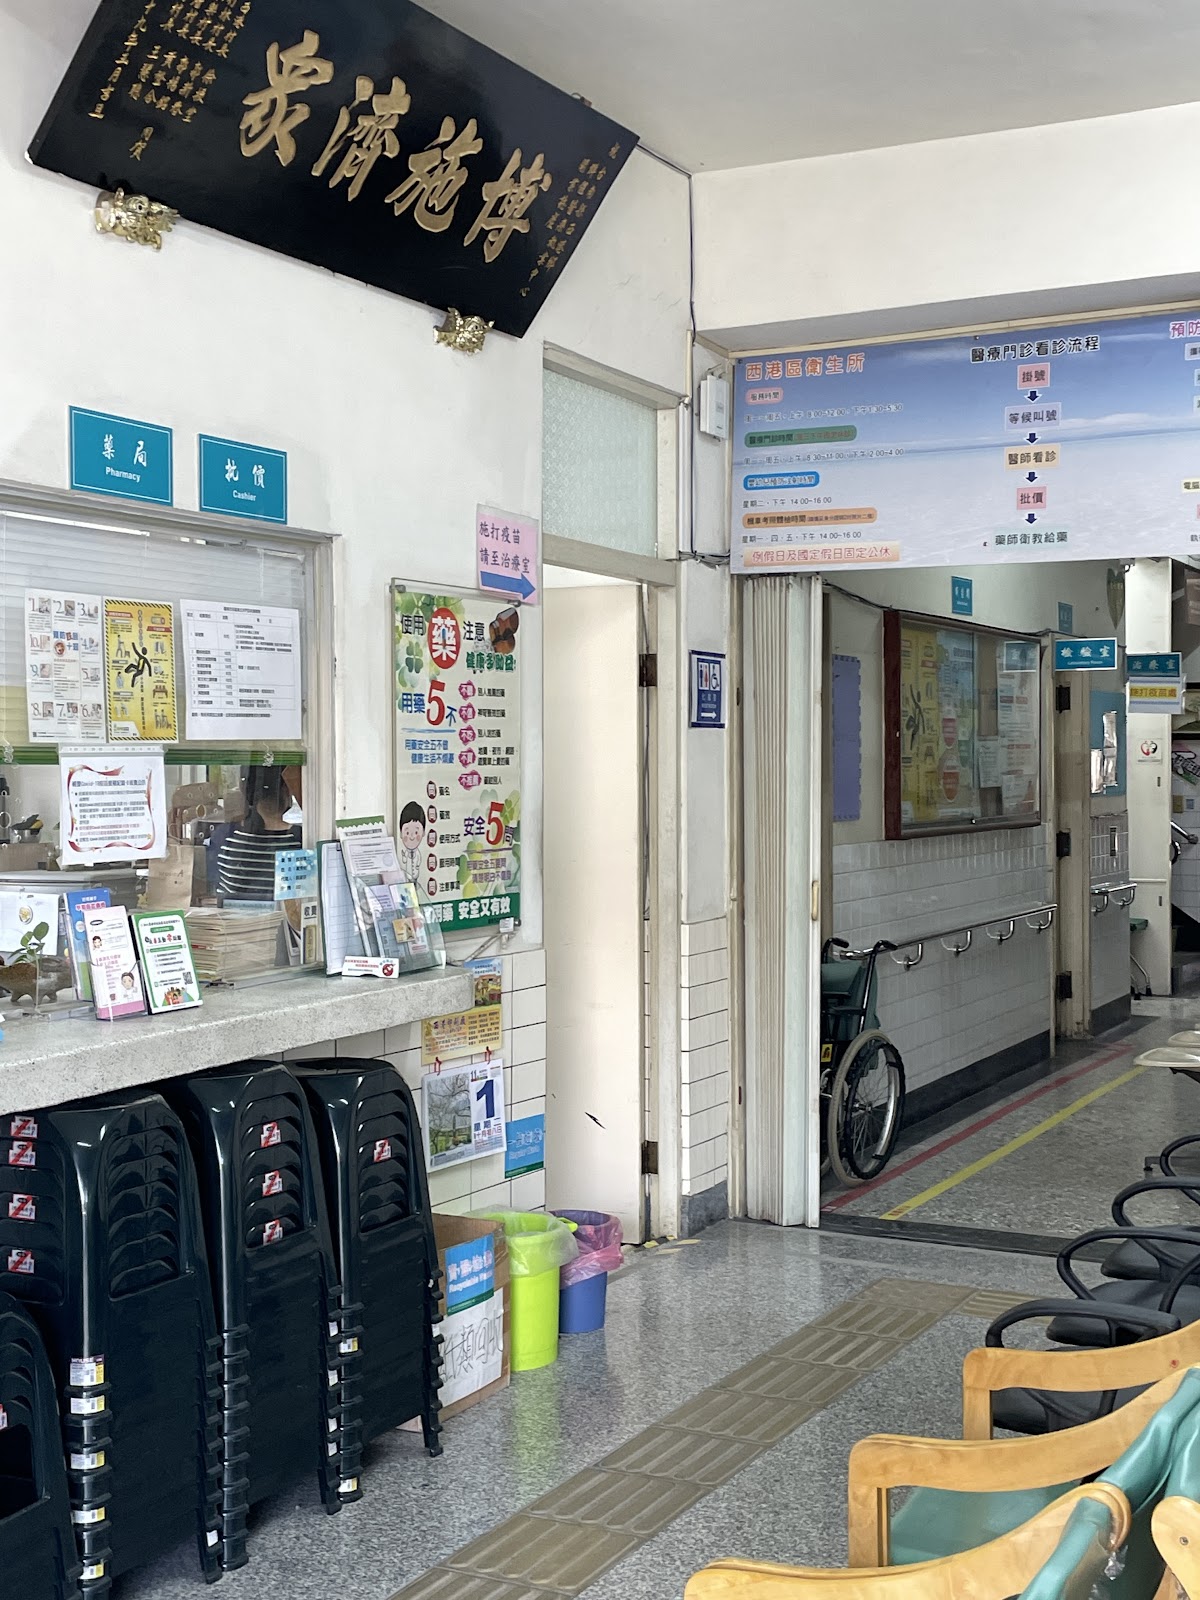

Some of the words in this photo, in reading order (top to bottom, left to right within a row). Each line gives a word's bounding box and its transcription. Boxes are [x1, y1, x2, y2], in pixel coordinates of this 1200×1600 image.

[970, 335, 1100, 363] 醫療門診看診流程
[745, 352, 866, 382] 西港區衛生所
[1021, 369, 1047, 383] 掛號
[1008, 410, 1058, 425] 等候叫號
[102, 433, 147, 468] 藥局
[1008, 450, 1057, 466] 醫師看診
[105, 466, 141, 483] Pharmacy
[232, 489, 257, 502] Cashier
[1019, 492, 1044, 505] 批價
[479, 521, 521, 545] 施打疫苗
[994, 531, 1069, 546] 藥師衛教給藥
[479, 547, 531, 574] 請至治療室
[751, 545, 891, 563] 例假日及國定假日固定公休
[439, 833, 461, 845] 使用方式
[458, 896, 511, 920] 安全又有效
[476, 1079, 495, 1119] 1
[474, 1117, 502, 1132] 星期二
